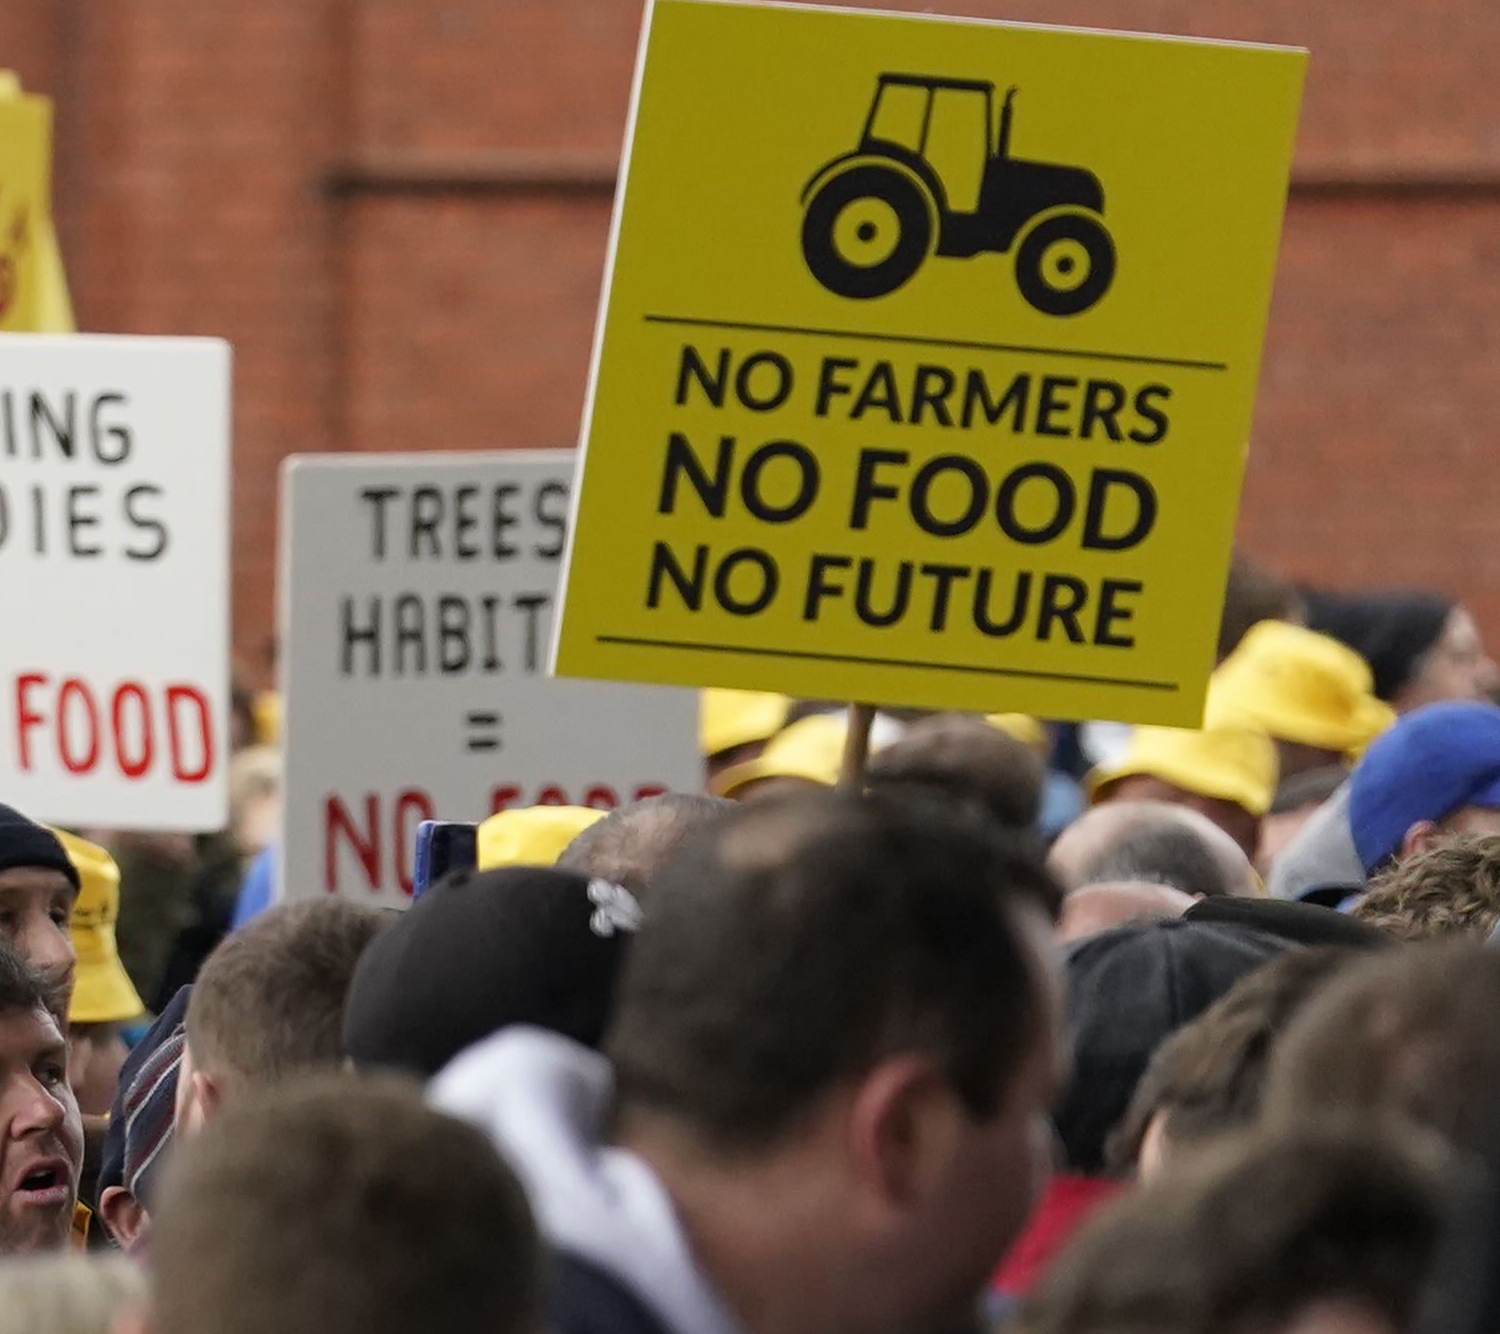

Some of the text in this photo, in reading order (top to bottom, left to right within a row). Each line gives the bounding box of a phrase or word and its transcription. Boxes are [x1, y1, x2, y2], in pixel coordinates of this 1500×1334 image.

[675, 344, 1172, 445] NO FARMERS
[360, 480, 568, 561] TREES
[657, 432, 1159, 552] NO FOOD
[645, 541, 1145, 649] NO FUTURE
[16, 673, 214, 784] FOOD
[325, 786, 436, 897] NO
